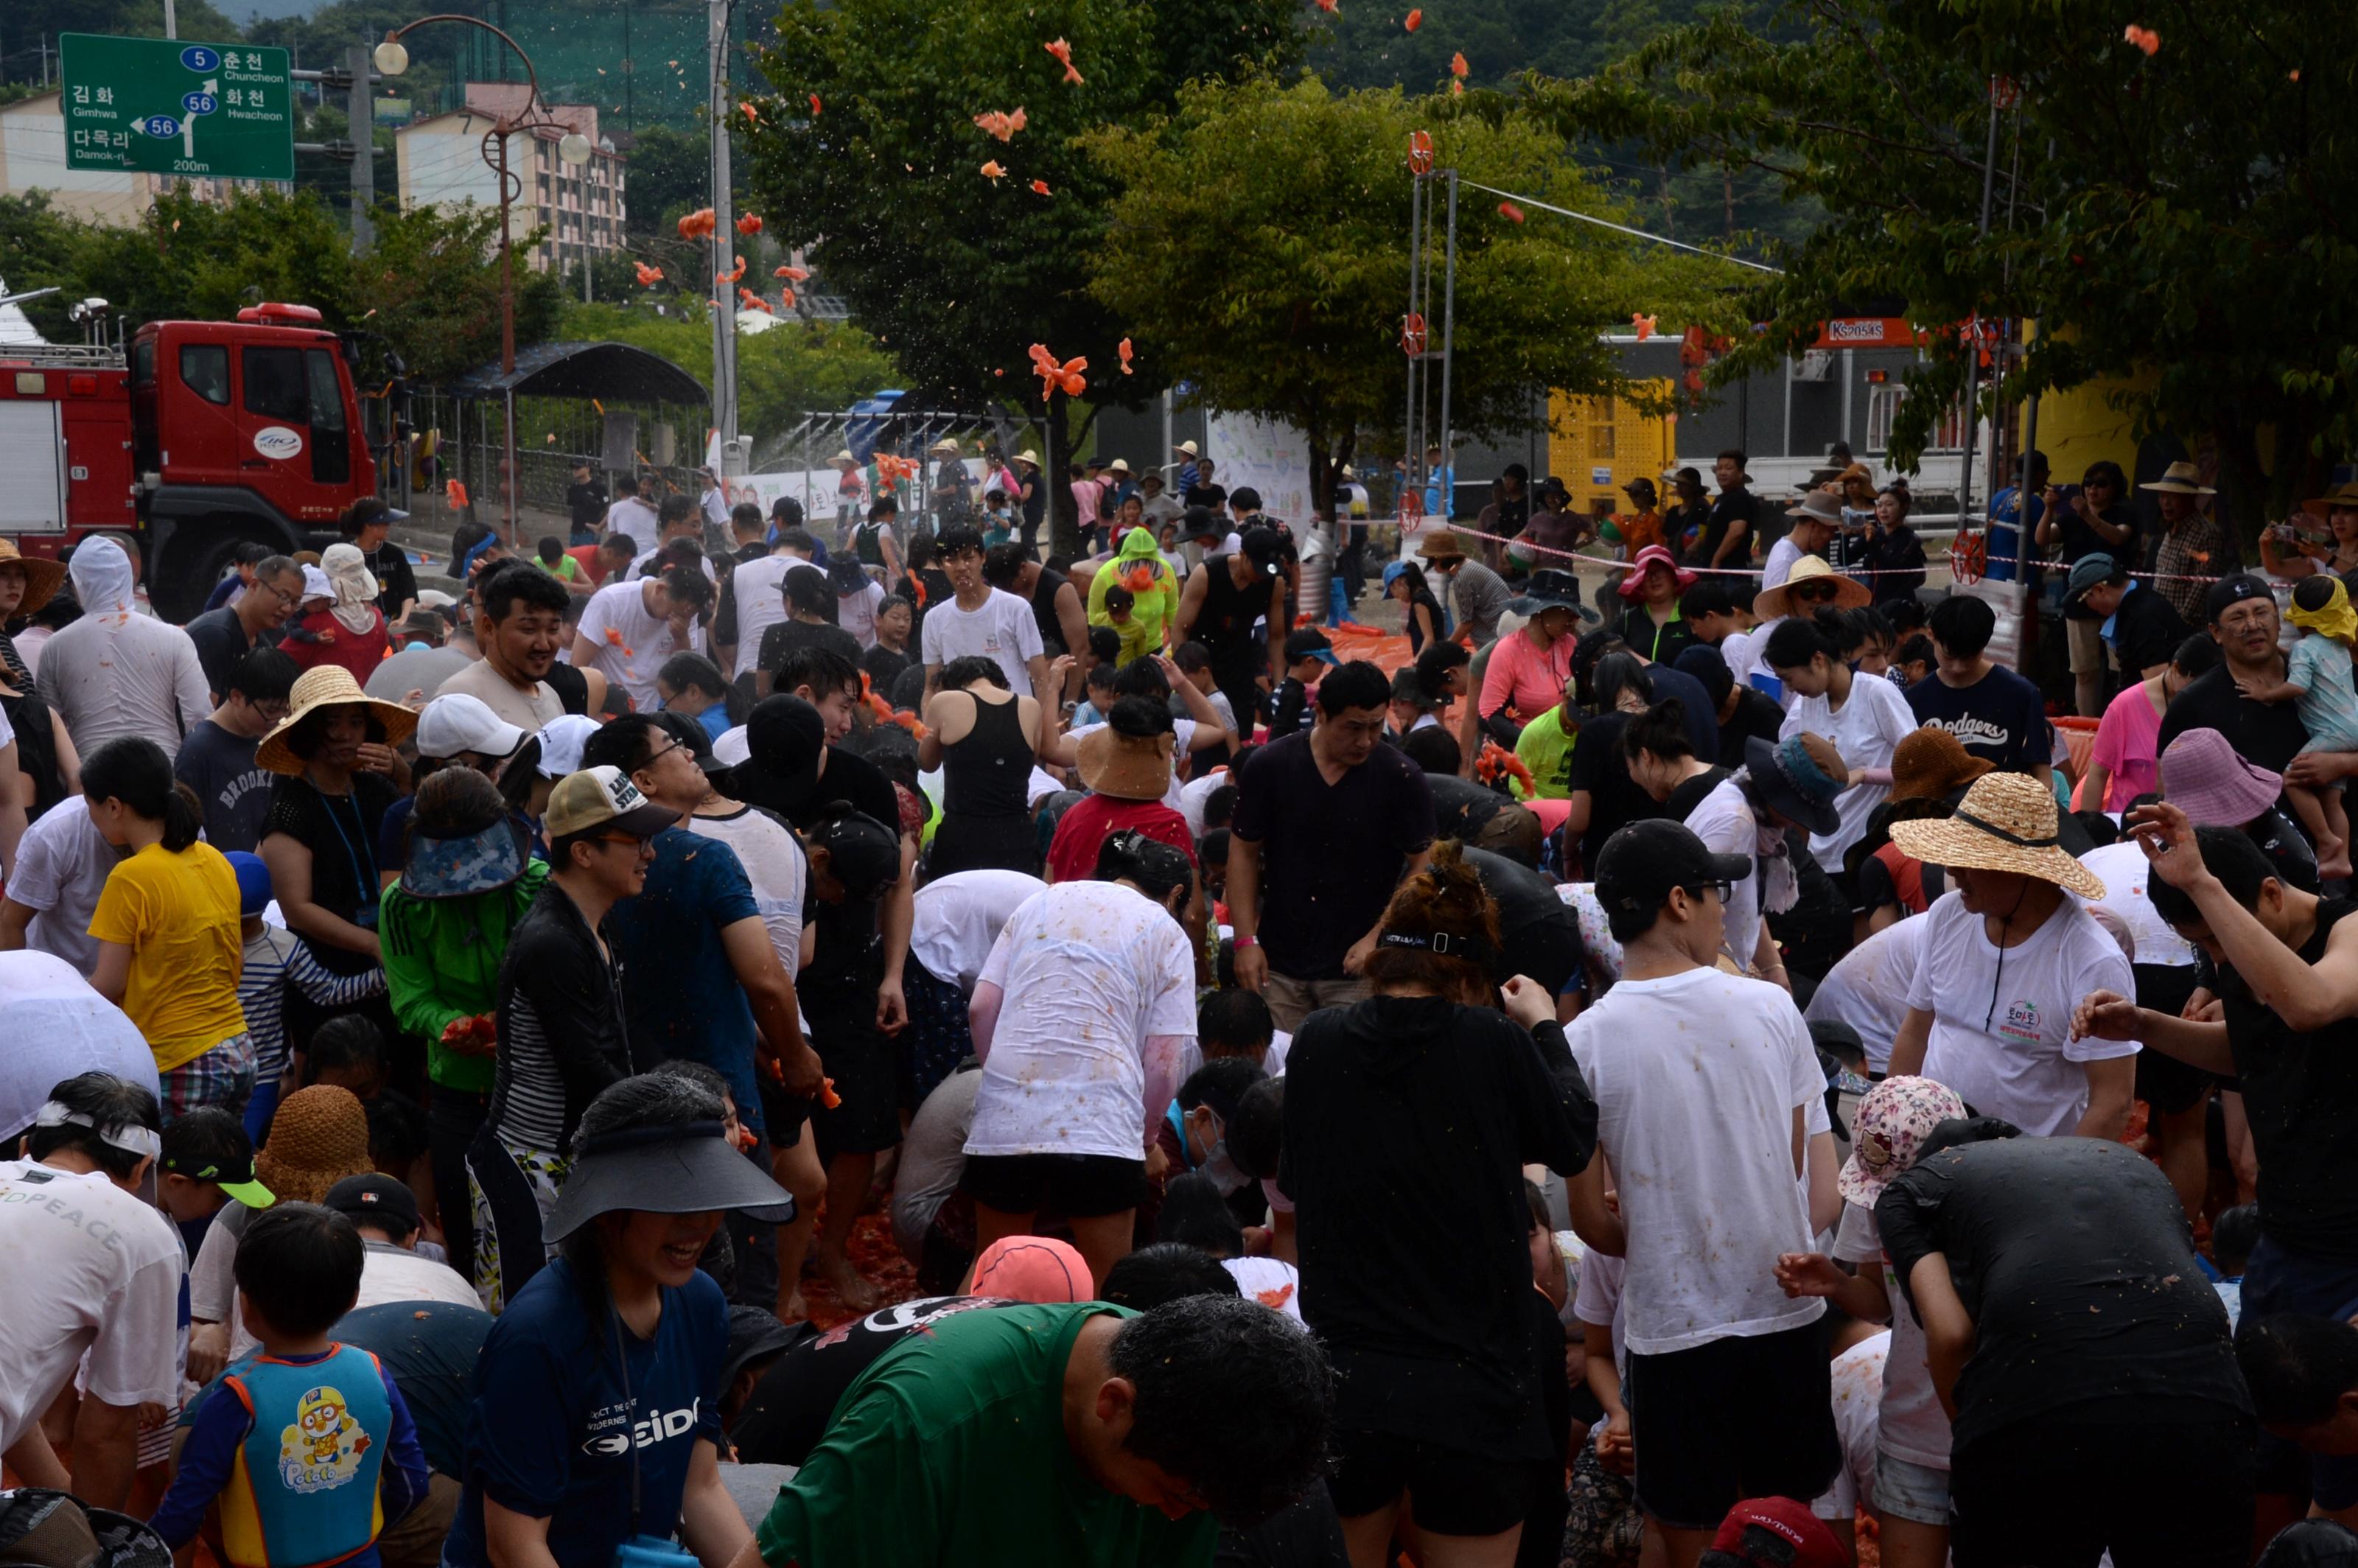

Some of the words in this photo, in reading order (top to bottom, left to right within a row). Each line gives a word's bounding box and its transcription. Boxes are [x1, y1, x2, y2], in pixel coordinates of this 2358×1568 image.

[195, 52, 206, 66] 5
[223, 52, 263, 71] 춘천
[224, 71, 284, 83] Chuncheon
[72, 85, 114, 105] 김화
[225, 88, 265, 108] 화천
[189, 96, 211, 111] 56
[72, 108, 118, 119] Gimhwa
[228, 109, 283, 122] Hwacheon
[151, 119, 174, 135] 56
[458, 113, 472, 134] 7
[73, 129, 130, 149] 다목리
[75, 149, 125, 161] Damok-ri
[173, 159, 210, 172] 200m
